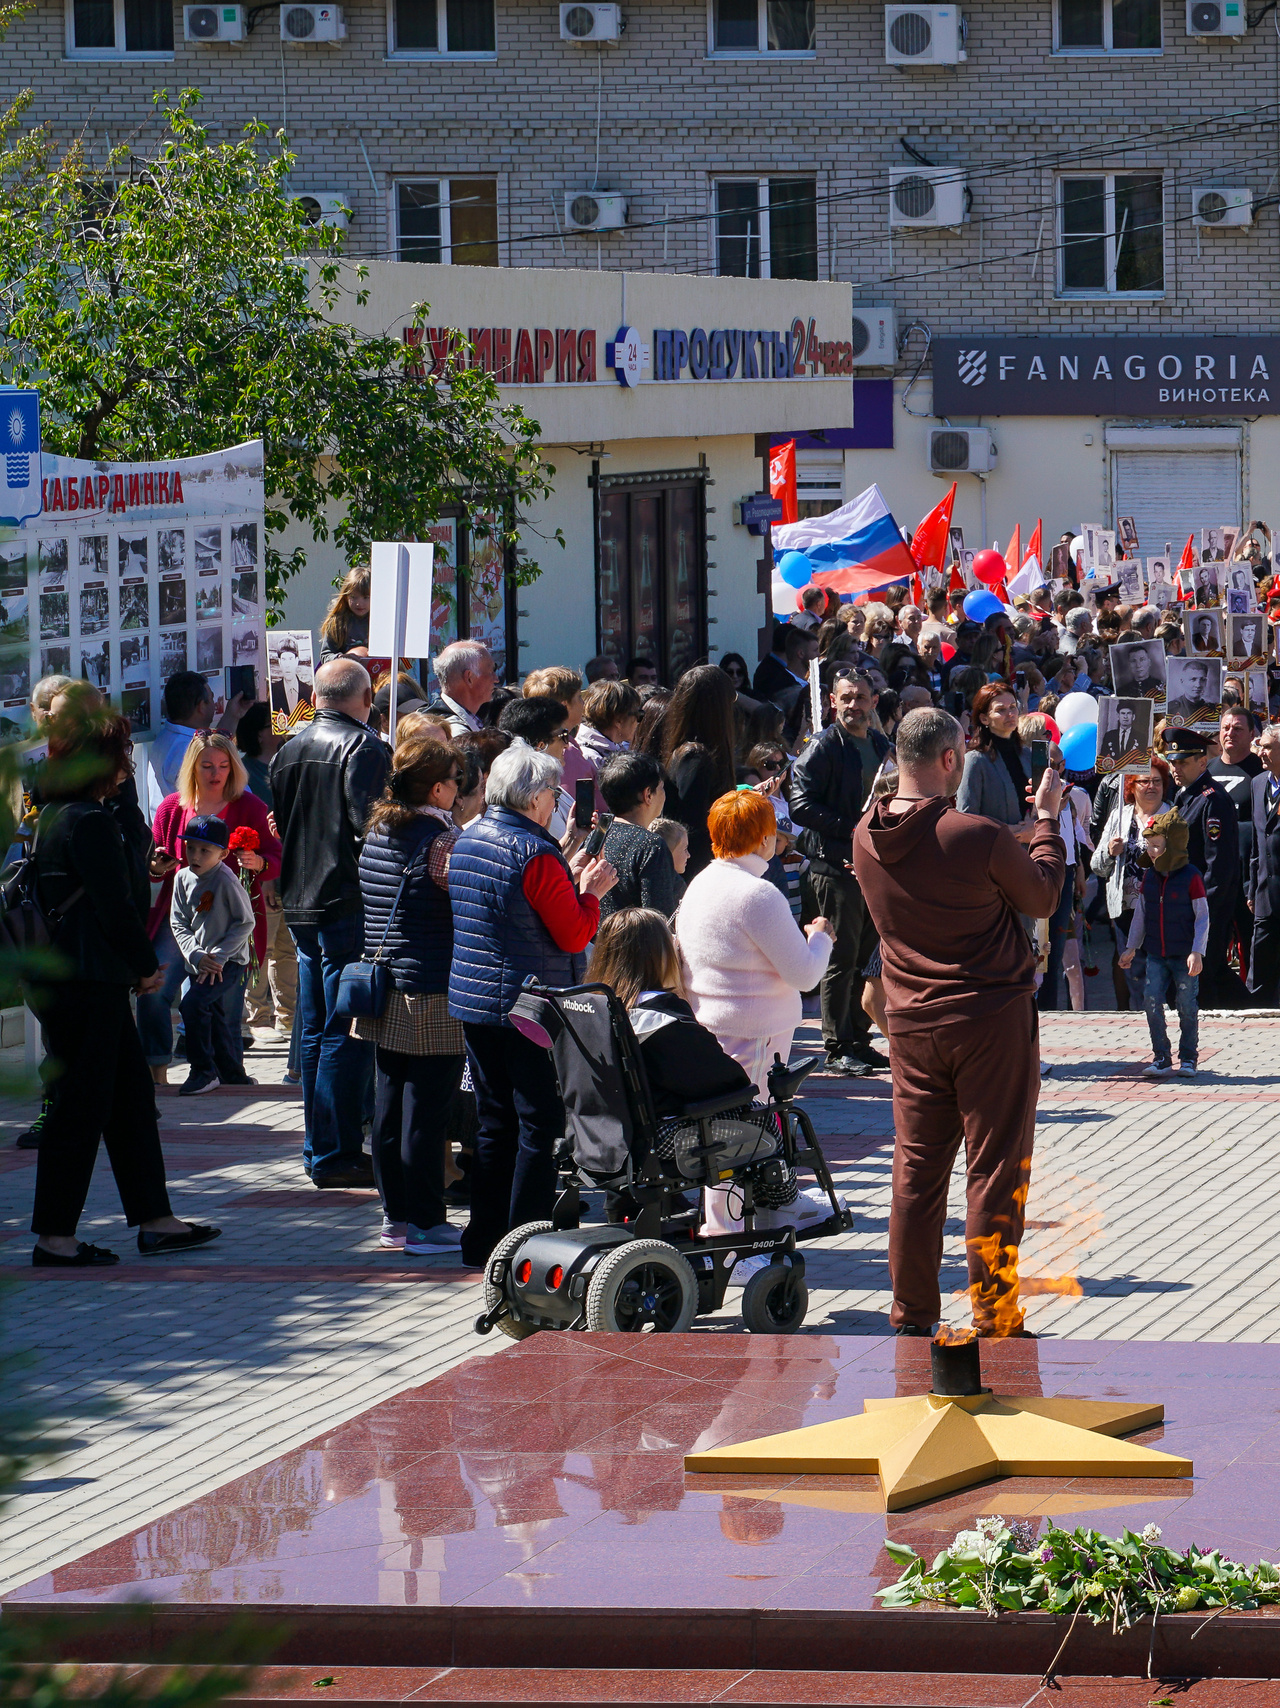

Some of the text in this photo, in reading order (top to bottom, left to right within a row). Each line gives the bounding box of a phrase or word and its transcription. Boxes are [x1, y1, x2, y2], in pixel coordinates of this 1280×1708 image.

[403, 327, 596, 385] КУЛИНАРИЯ
[628, 344, 638, 362] 24
[653, 328, 794, 380] ПРОДУКТЫ
[1000, 355, 1270, 380] FANAGORIA
[1159, 388, 1270, 402] ВИНОТЕКА
[760, 519, 768, 532] 80
[752, 1240, 774, 1249] B400
